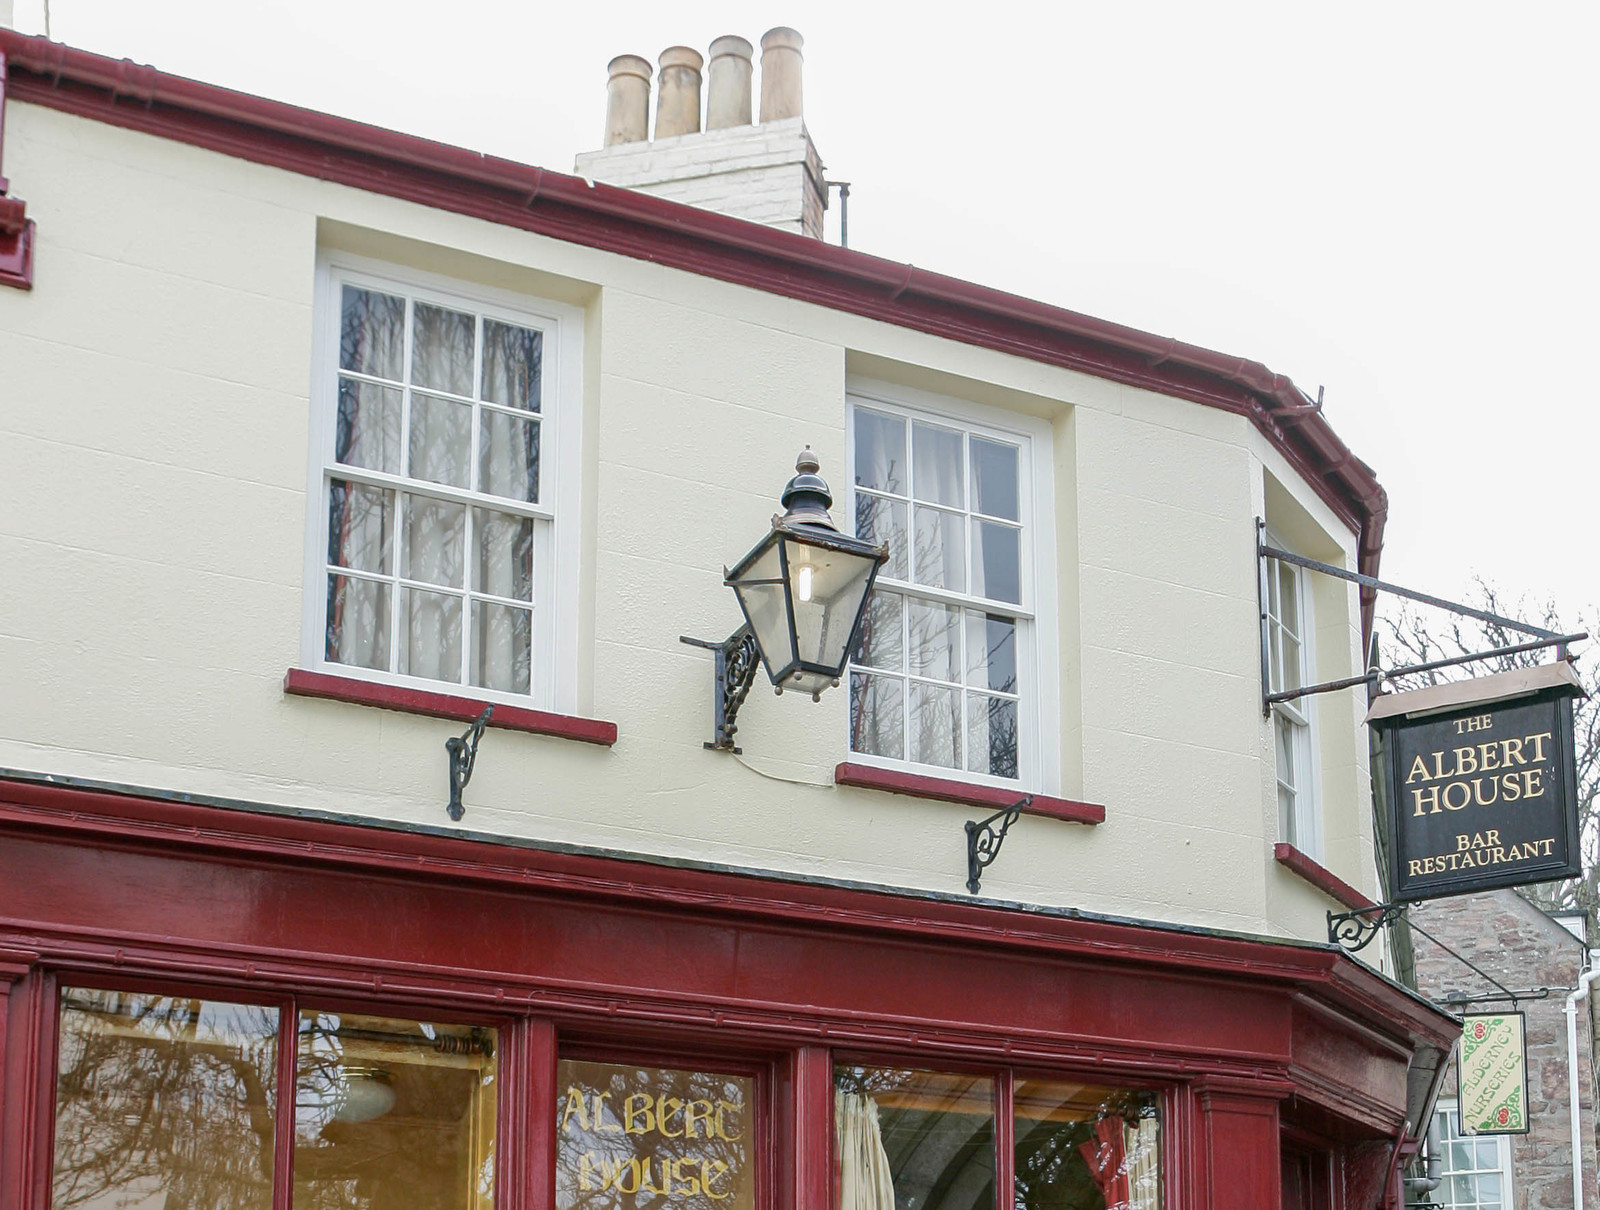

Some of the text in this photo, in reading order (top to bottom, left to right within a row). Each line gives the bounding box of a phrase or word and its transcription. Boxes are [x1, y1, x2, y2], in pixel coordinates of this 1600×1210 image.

[1453, 714, 1493, 735] THE
[1405, 732, 1552, 784] ALBERT
[1411, 768, 1545, 817] HOUSE
[1408, 838, 1555, 877] RESTAURANT
[1456, 829, 1502, 852] BAR
[1462, 1025, 1512, 1097] ALDERNEY
[1464, 1052, 1522, 1125] NURSERIES
[561, 1086, 746, 1142] ALBERT
[579, 1150, 730, 1200] HOUSE
